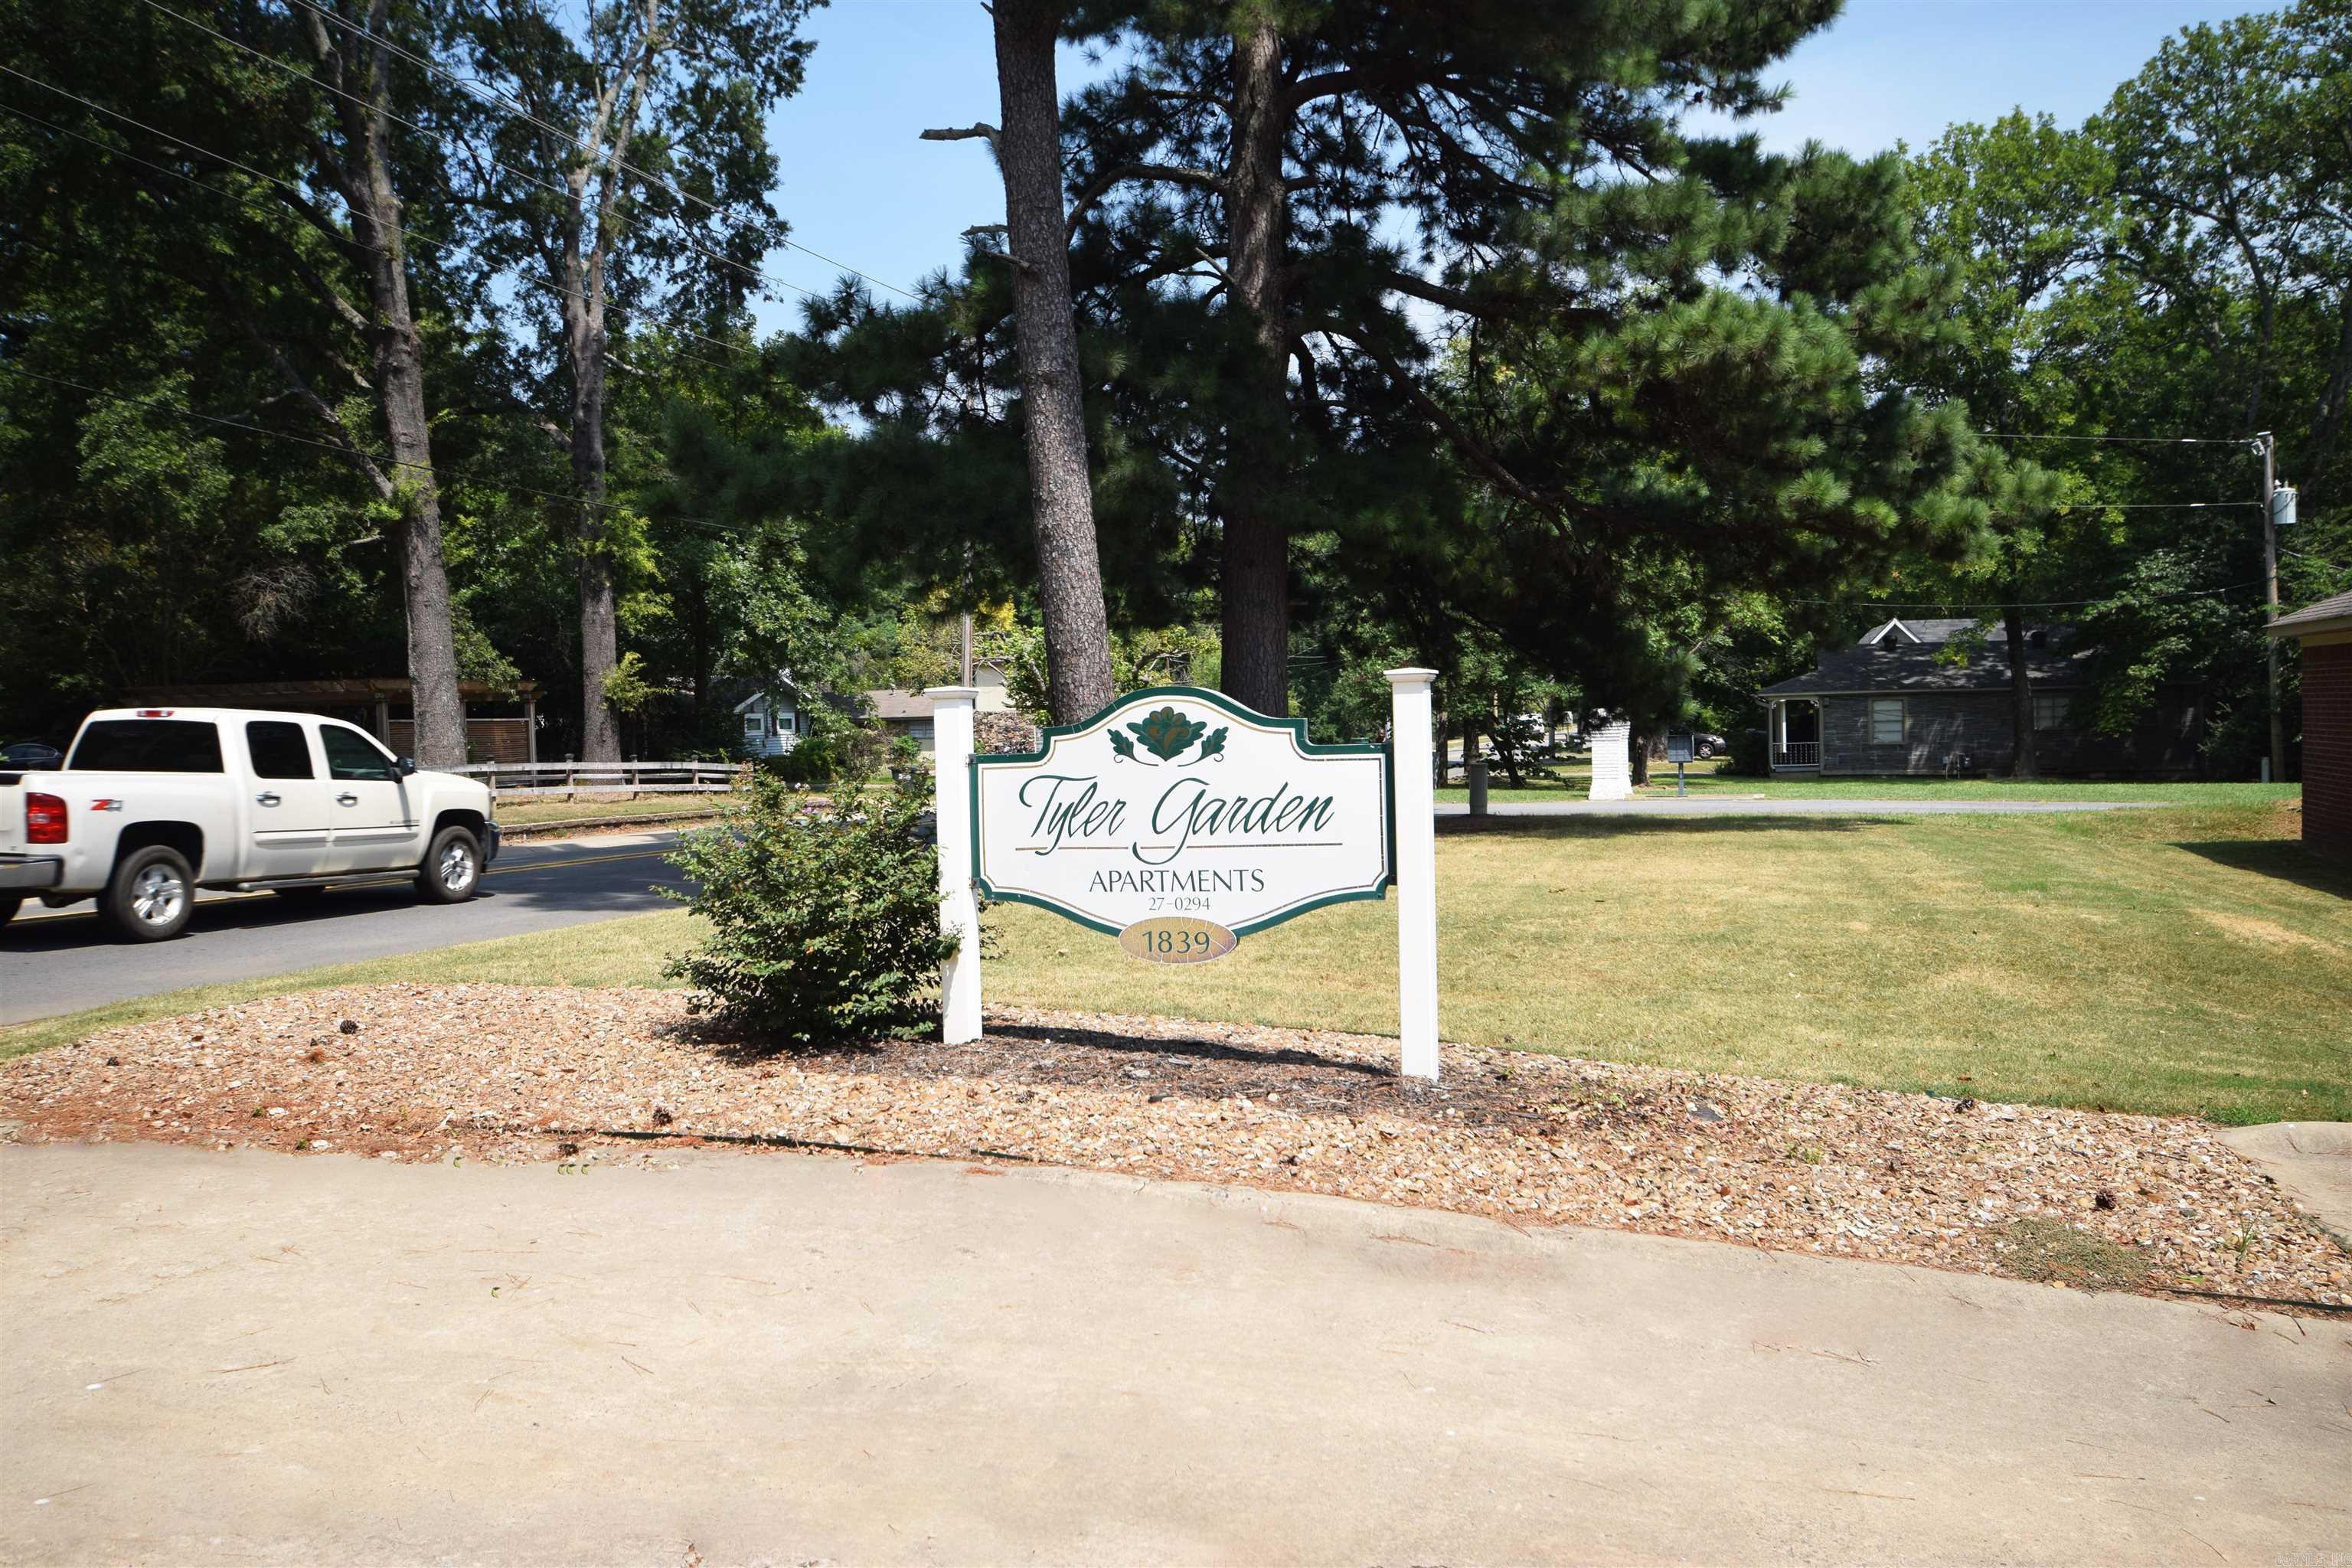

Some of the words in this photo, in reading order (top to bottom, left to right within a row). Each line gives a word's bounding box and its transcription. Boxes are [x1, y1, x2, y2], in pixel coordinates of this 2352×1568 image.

[1018, 774, 1127, 856] Tyler
[1132, 777, 1334, 865] Garden
[1089, 868, 1265, 893] APARTMENTS
[1148, 897, 1210, 911] 27-0294
[1142, 929, 1210, 955] 1839
